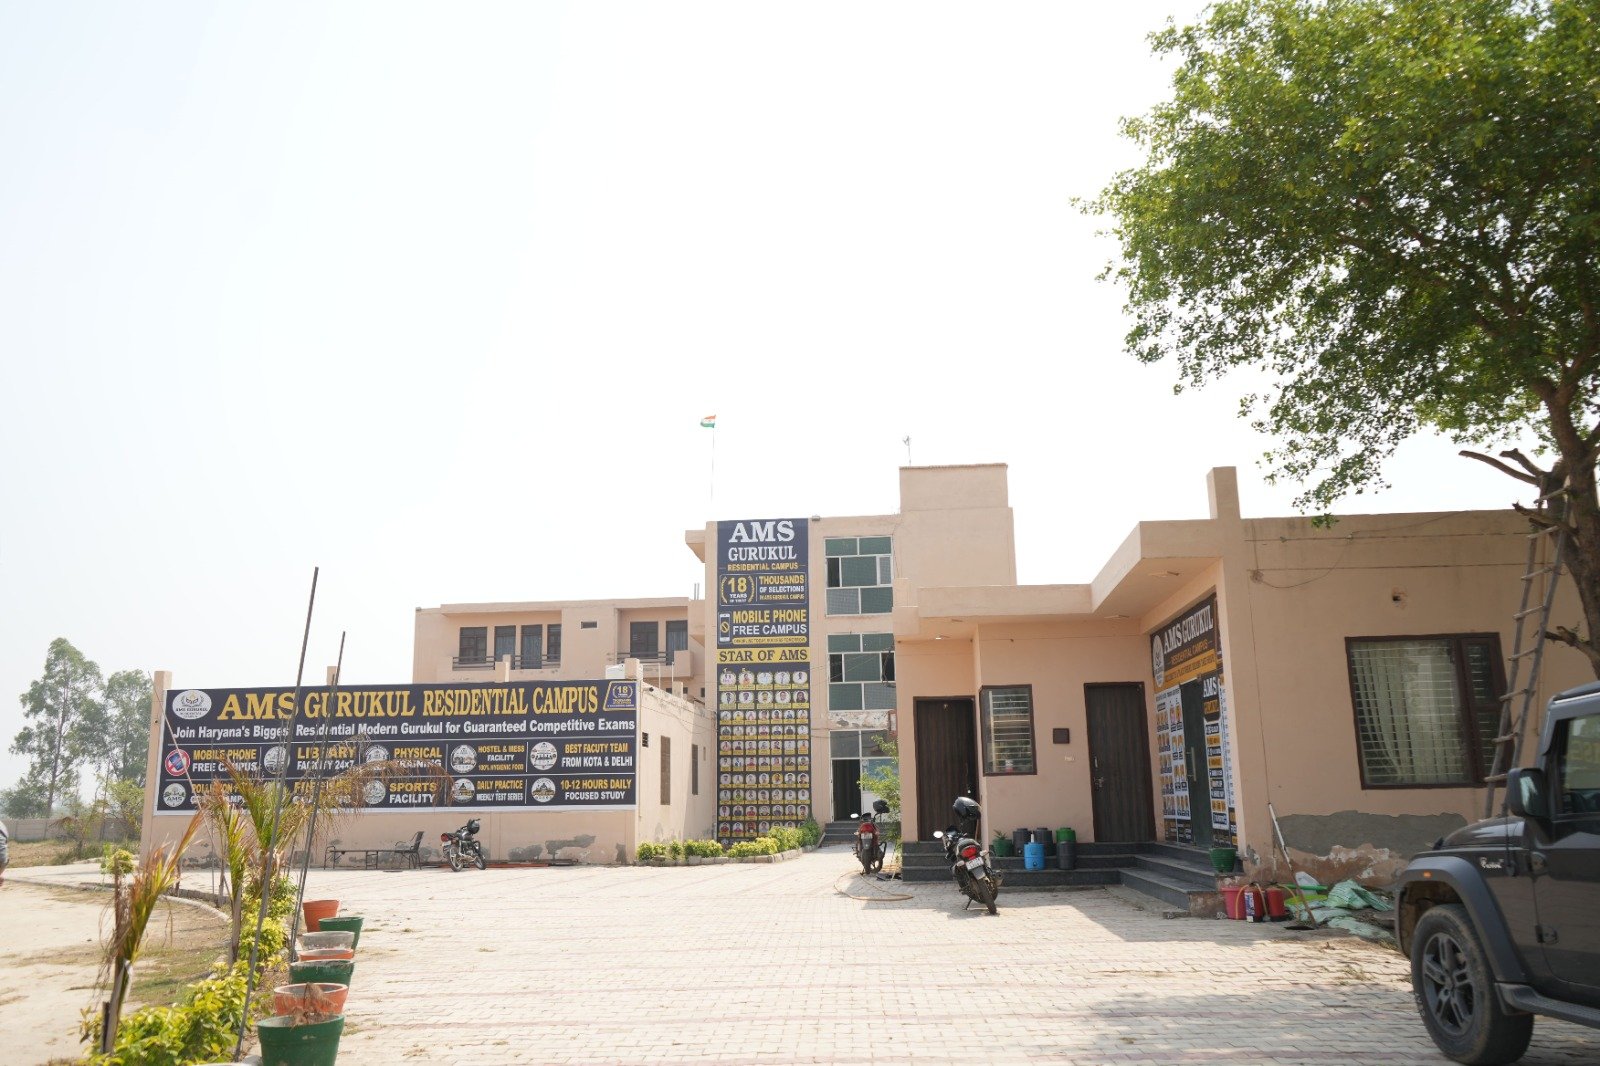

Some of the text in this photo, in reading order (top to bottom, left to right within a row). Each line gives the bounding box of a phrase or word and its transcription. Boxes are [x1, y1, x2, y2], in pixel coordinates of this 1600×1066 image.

[728, 520, 795, 543] AMS
[728, 546, 798, 562] GURUKUL
[727, 562, 799, 572] RESIDENTIAL CAMPUS
[727, 577, 748, 593] 18
[759, 575, 805, 585] THOUSANDS
[768, 585, 805, 593] SELECTIONS
[732, 609, 807, 624] MOBILE PHONE
[732, 624, 807, 636] FREE CAMPUS
[1163, 604, 1214, 655] AMS GURUKUL
[719, 649, 808, 662] STAR OF AMS
[617, 685, 628, 694] 18
[1203, 676, 1217, 698] AMS
[217, 692, 299, 720] AMS
[422, 687, 529, 717] RESIDENTIAL
[532, 685, 598, 715] CAMPUS
[173, 726, 196, 739] Join
[198, 725, 250, 741] Haryana's
[253, 724, 294, 740] Bigges
[358, 722, 398, 735] Modern
[400, 722, 443, 735] Gurukul
[446, 721, 461, 733] for
[463, 719, 527, 733] Guaranteed
[529, 718, 595, 735] Competitive
[598, 718, 635, 731] Exams
[193, 748, 257, 760] MOBILE PHONE
[297, 746, 357, 759] LIBARY
[393, 747, 442, 758] PHYSICAL
[477, 745, 501, 753] HOSTEL
[508, 745, 525, 753] MESS
[564, 744, 582, 754] BEST
[610, 743, 628, 753] TEAM
[487, 754, 515, 762] FACILITY
[561, 756, 633, 767] FROM KOTA & DELHI
[192, 762, 216, 772] FREE
[389, 782, 437, 792] SPORTS
[476, 780, 524, 790] DAILY PRACTICE
[560, 779, 632, 790] 10-12 HOURS DAILY
[389, 793, 436, 804] FACILITY
[476, 793, 524, 801] WEEKLY TEST SERIES
[564, 791, 626, 800] FOCUSED STUDY
